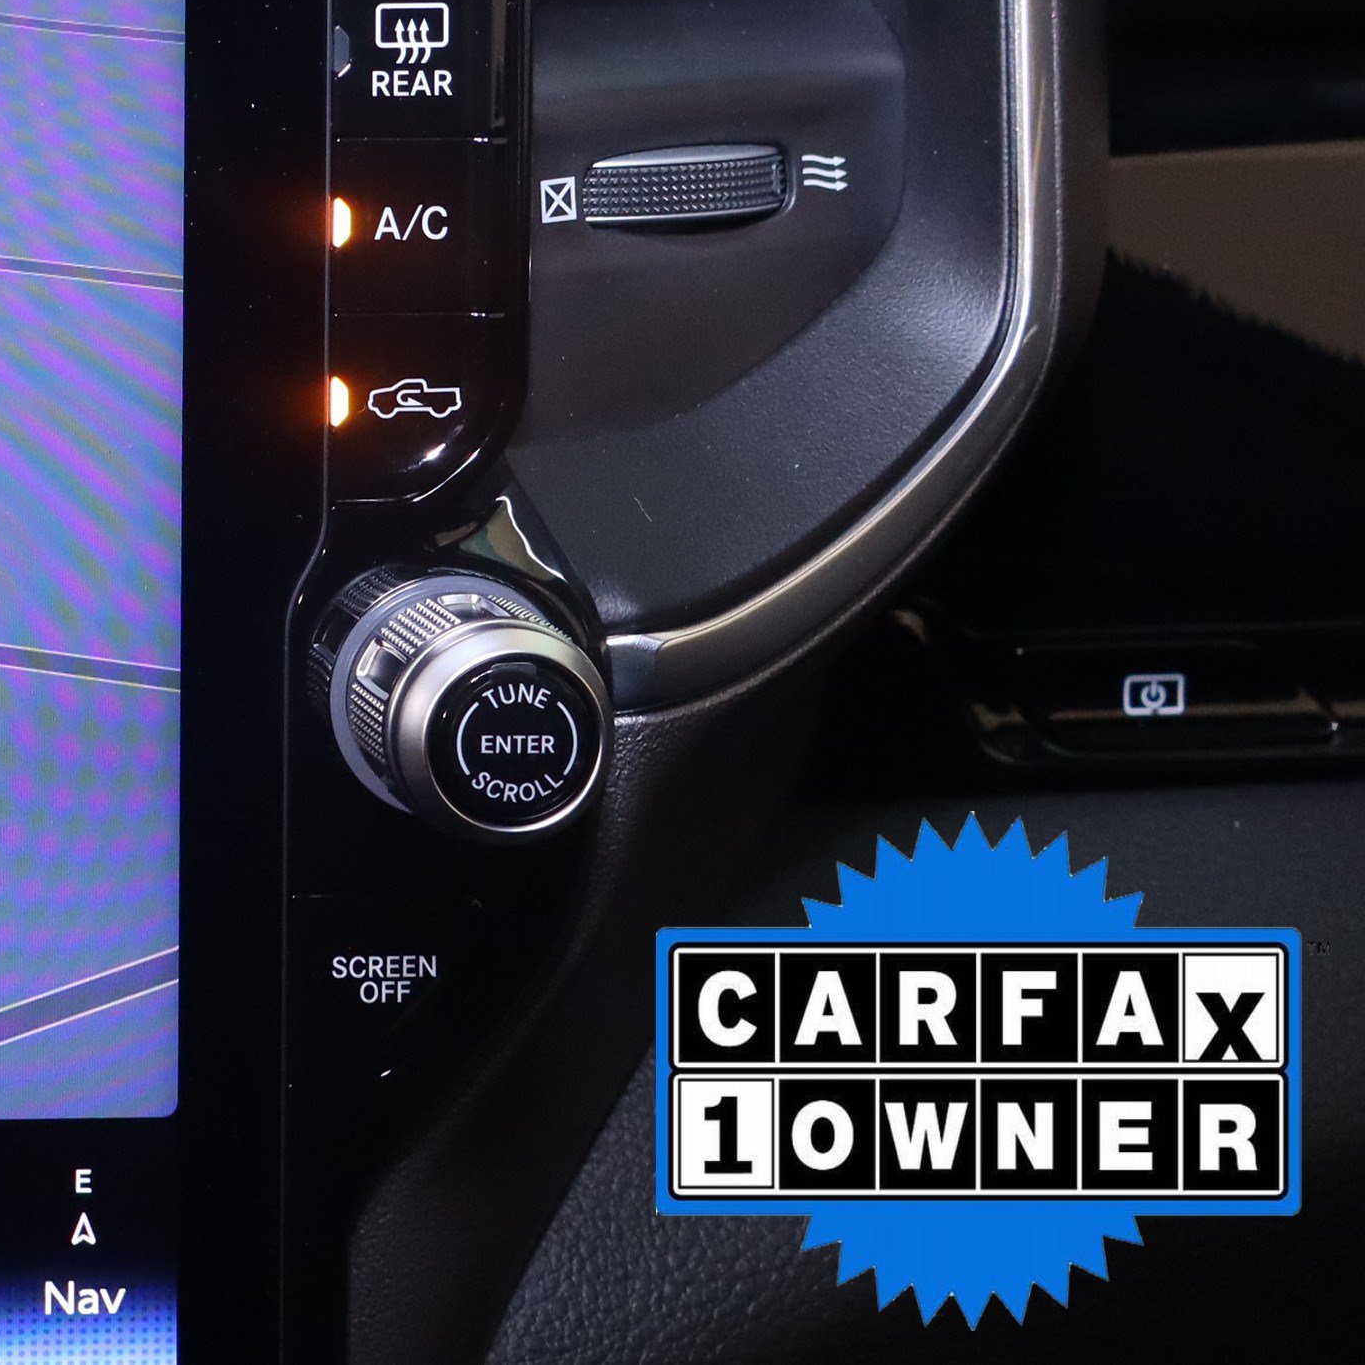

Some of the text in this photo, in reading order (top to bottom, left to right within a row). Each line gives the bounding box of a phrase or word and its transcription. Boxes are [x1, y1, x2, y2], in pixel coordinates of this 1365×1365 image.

[372, 70, 453, 97] REAR
[373, 205, 449, 241] A/C
[482, 683, 552, 710] TUNE
[480, 735, 555, 755] ENTER
[470, 771, 564, 804] SCROLL
[332, 955, 437, 979] SCREEN
[360, 981, 411, 1003] OFF
[75, 1169, 92, 1194] E
[43, 1281, 125, 1315] Nav
